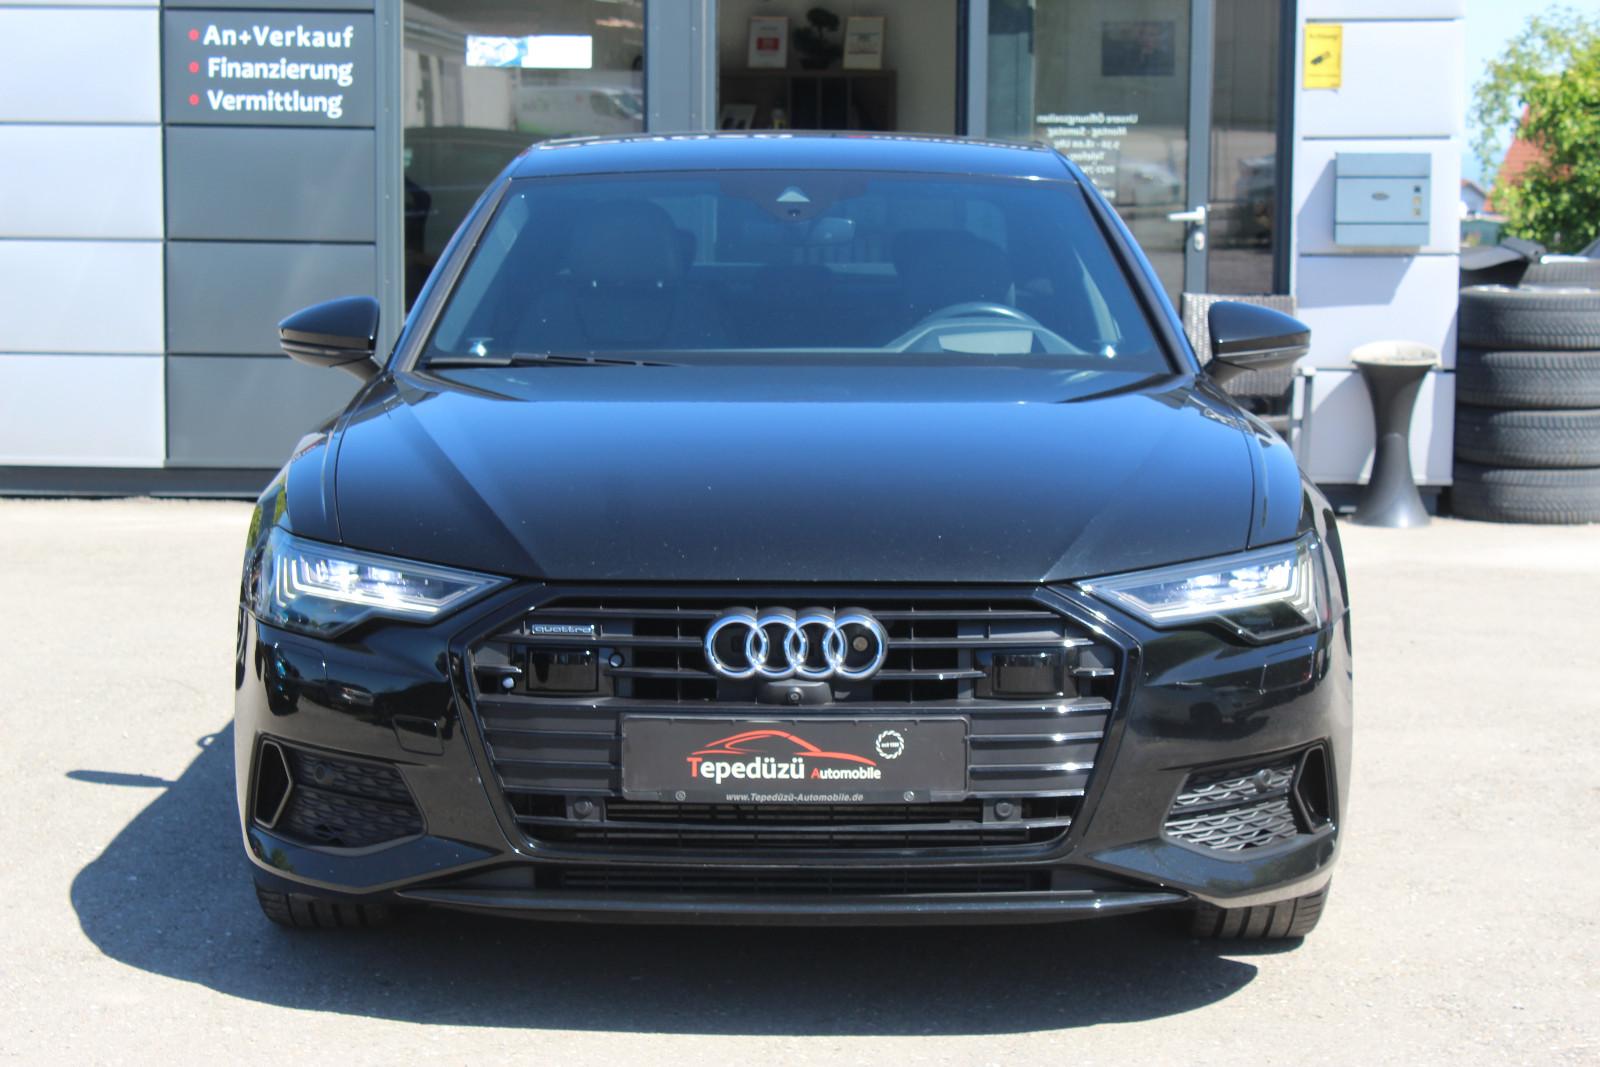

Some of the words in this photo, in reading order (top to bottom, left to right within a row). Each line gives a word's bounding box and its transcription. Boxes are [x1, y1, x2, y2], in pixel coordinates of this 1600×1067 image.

[203, 25, 353, 48] An+Verkauf
[208, 57, 353, 87] Finanzierung
[207, 89, 343, 119] Vermittlung
[535, 625, 593, 634] quattro
[687, 756, 805, 785] Tepedüzü
[810, 766, 882, 781] Automobile
[726, 792, 864, 803] www.Tepedüzü-Automobile.de
